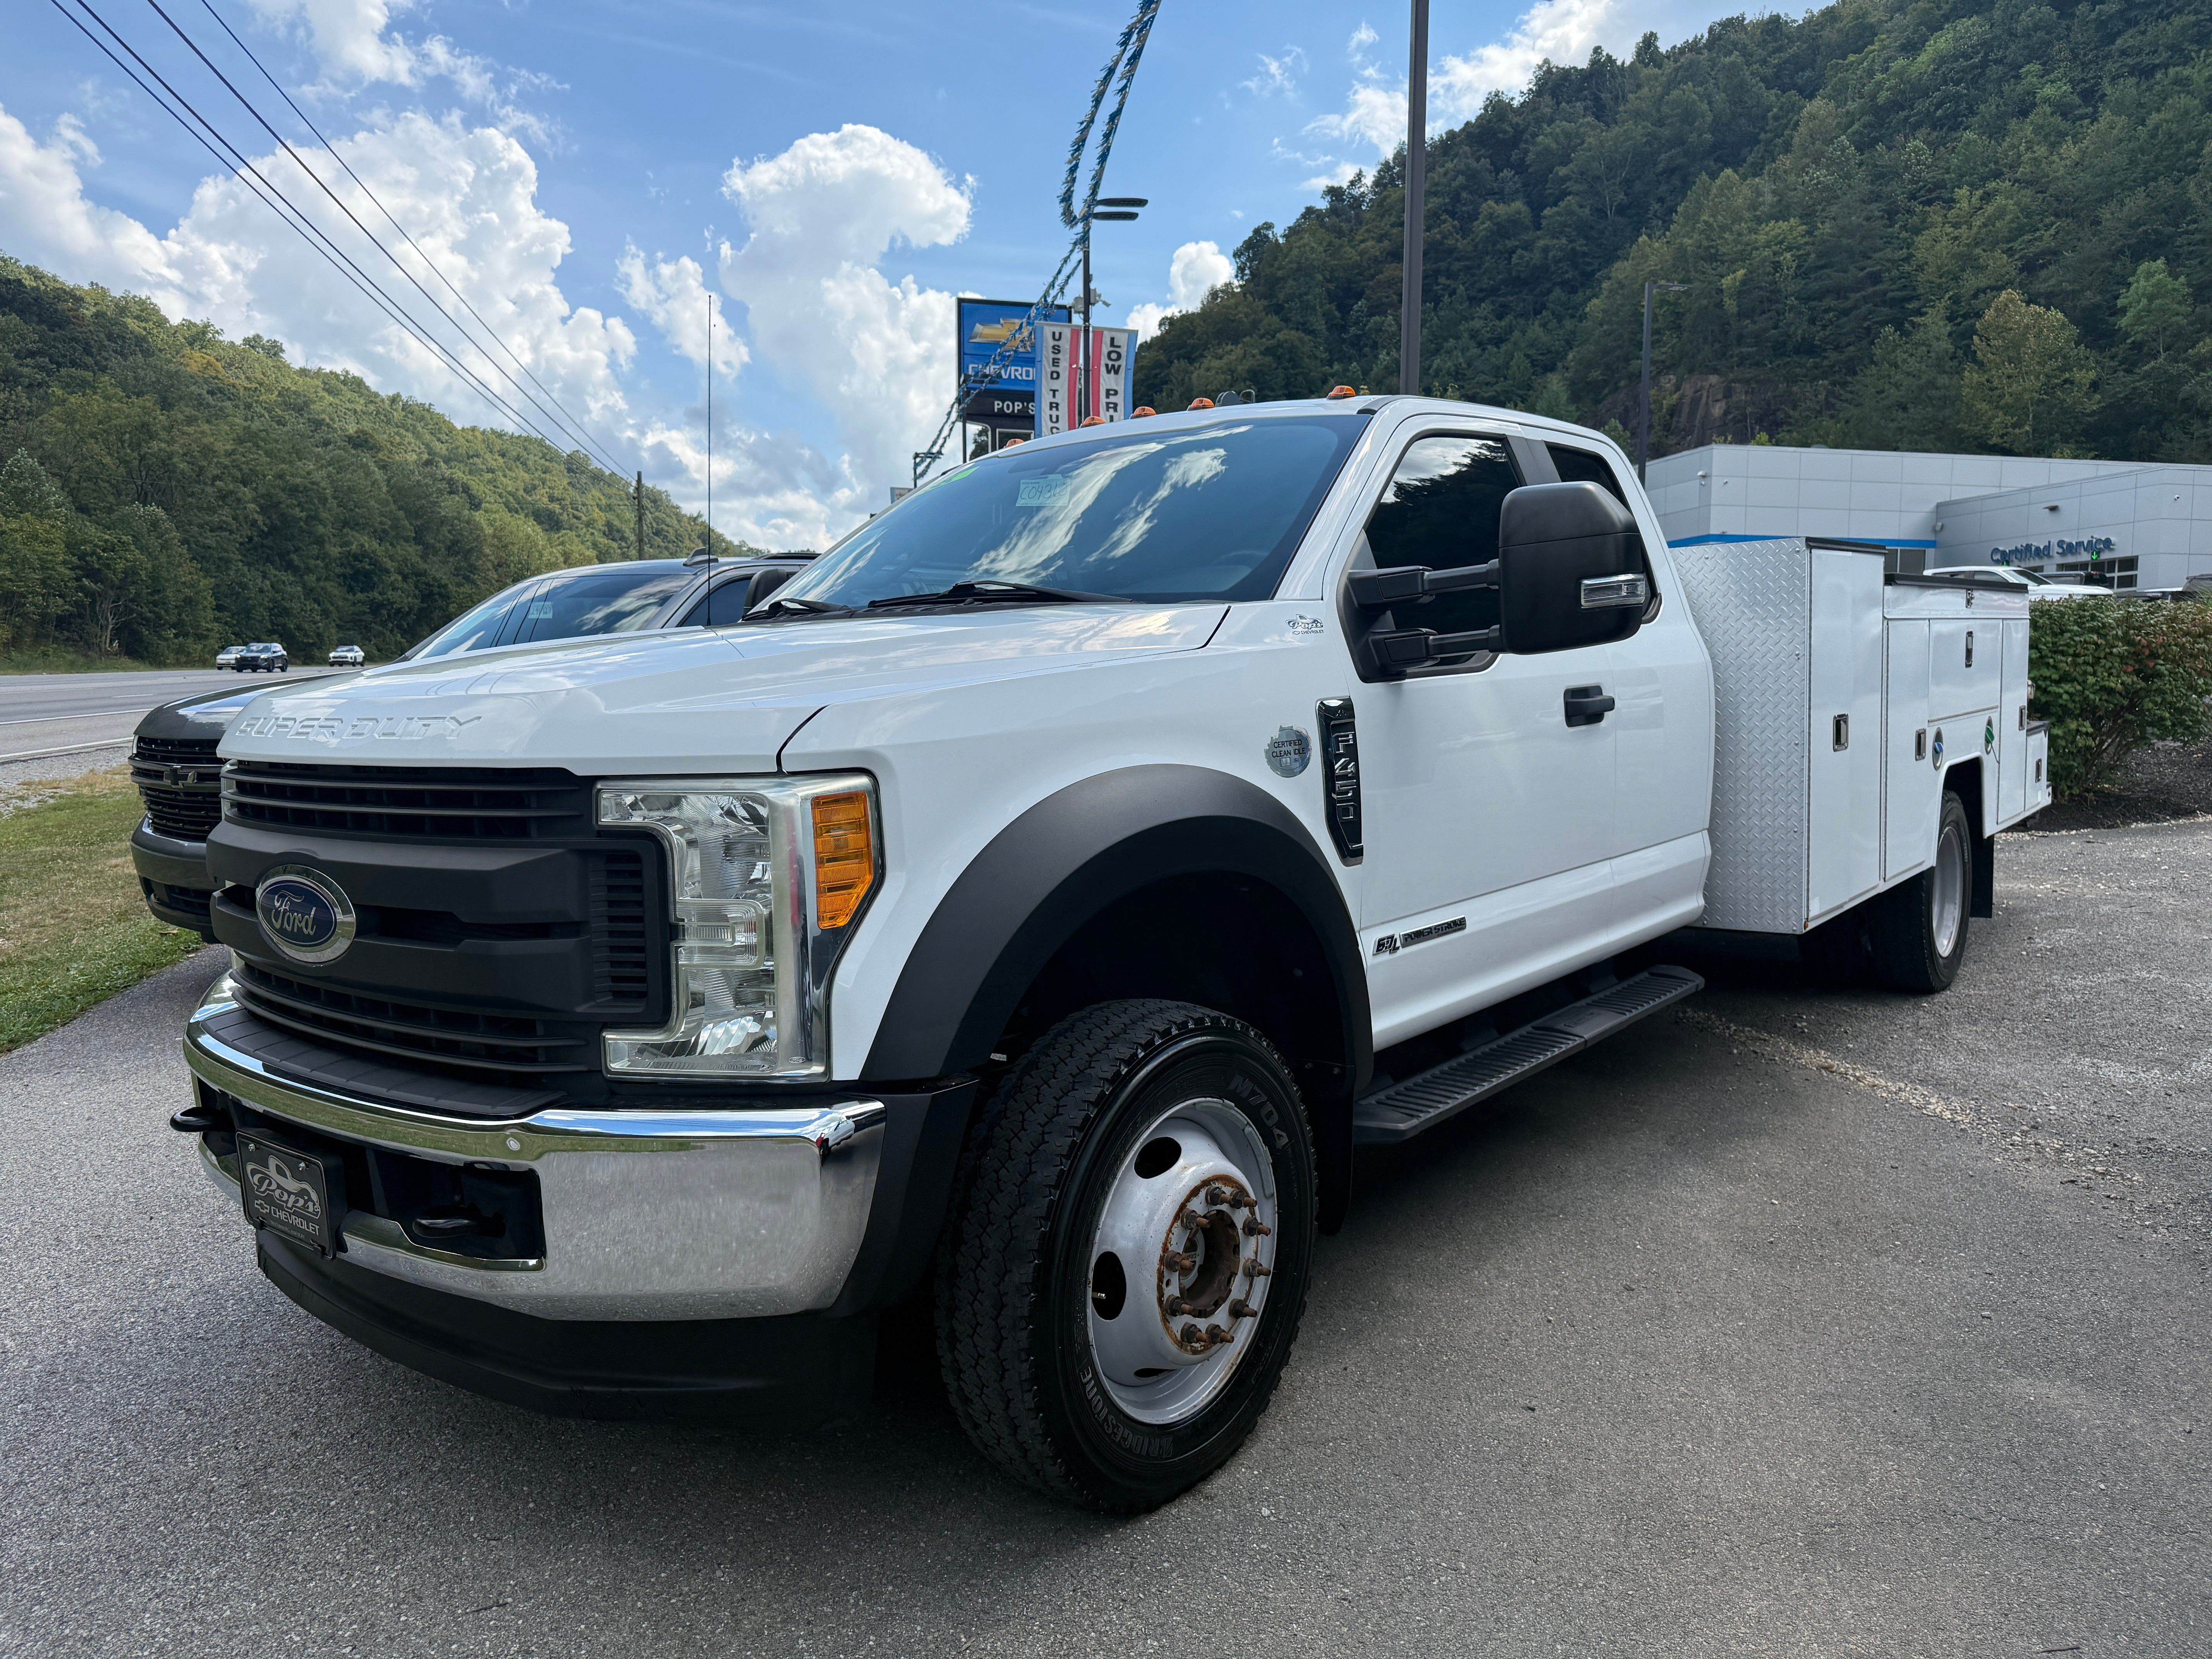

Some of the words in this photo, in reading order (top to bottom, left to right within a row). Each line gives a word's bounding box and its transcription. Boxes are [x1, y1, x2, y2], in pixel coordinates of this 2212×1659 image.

[1050, 331, 1062, 380] USED
[1105, 337, 1122, 375] LOW
[969, 364, 1036, 380] CHEVRO
[994, 400, 1036, 415] POP'S
[1049, 389, 1060, 434] TRUC
[1105, 388, 1118, 422] PRI
[1990, 541, 2051, 562] Certified
[2056, 535, 2113, 555] Service
[235, 716, 344, 740] SUPER
[342, 716, 483, 740] DUTY
[1271, 749, 1291, 758] CLEAN
[1273, 739, 1302, 749] CERTIFIED
[271, 890, 316, 936] Ford
[1403, 927, 1433, 942] POWER
[1434, 919, 1465, 934] STROKE
[1226, 1072, 1289, 1149] M704
[253, 1173, 317, 1214] Pop's
[271, 1206, 319, 1236] CHEVROLET
